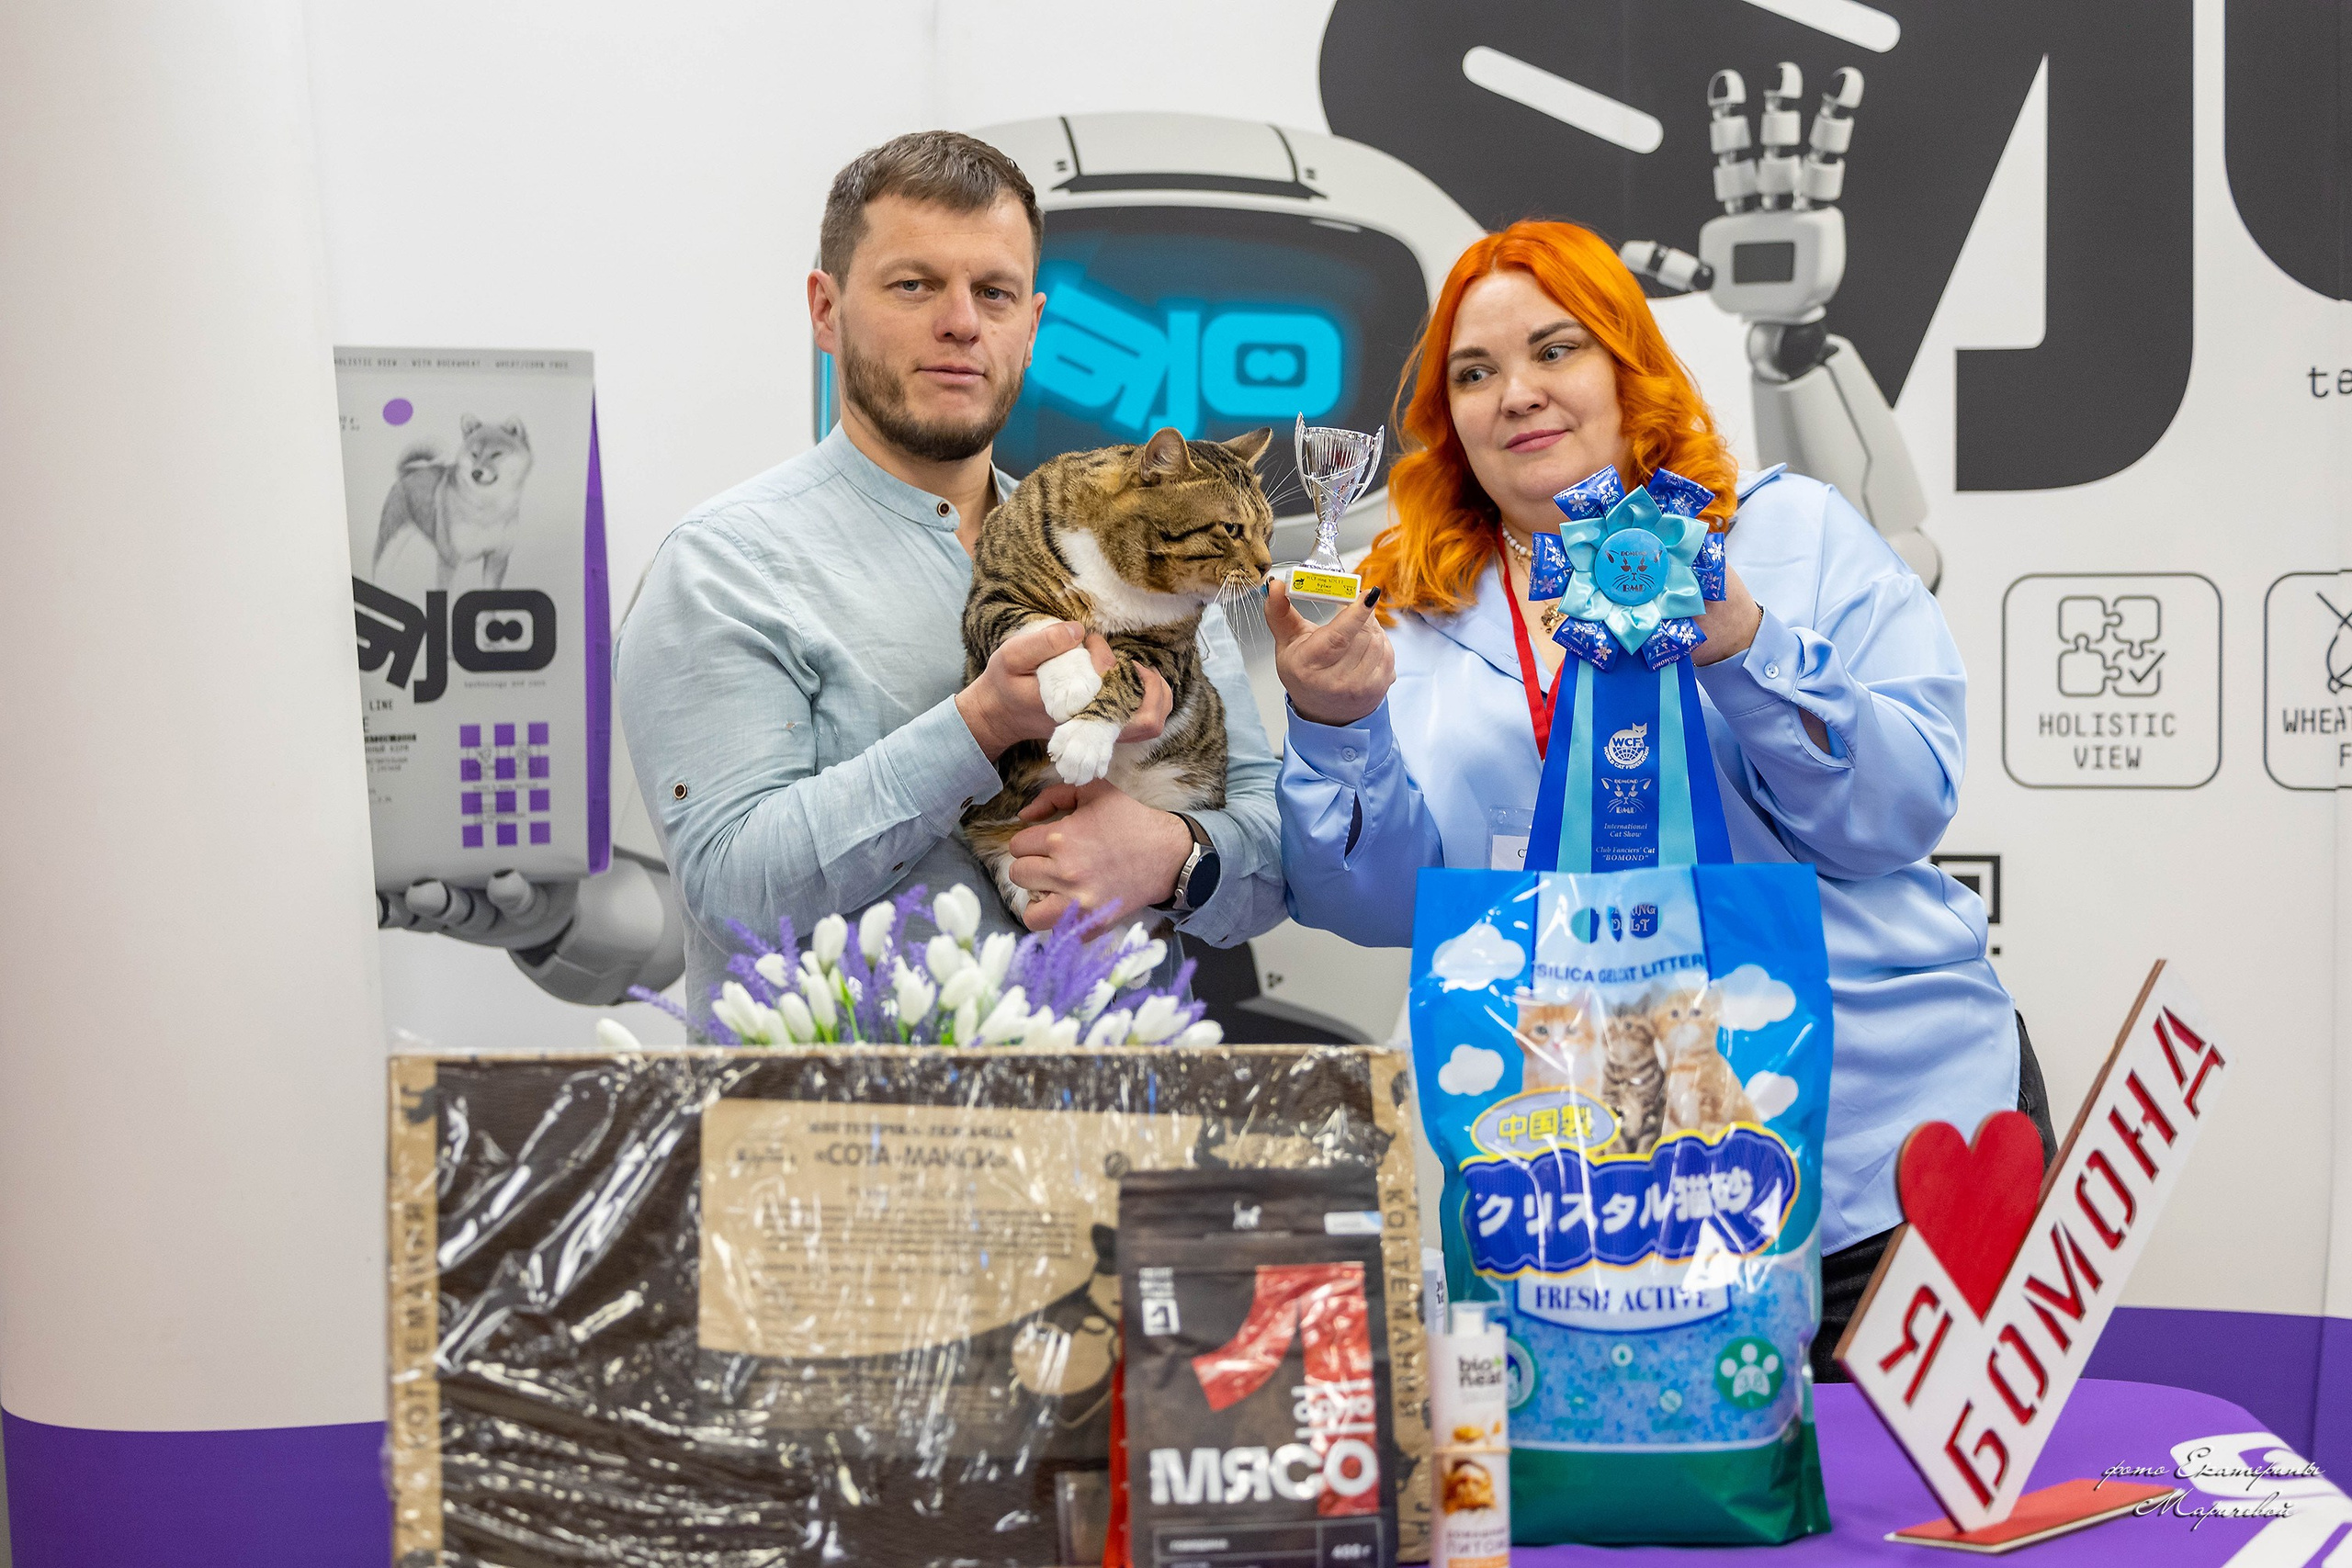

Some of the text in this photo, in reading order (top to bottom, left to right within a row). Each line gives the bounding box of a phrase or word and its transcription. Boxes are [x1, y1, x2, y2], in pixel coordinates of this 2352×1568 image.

[1623, 584, 1647, 592] BMD
[369, 698, 393, 712] LINE
[2038, 713, 2177, 738] HOLISTIC
[1612, 737, 1641, 747] WCF
[1603, 746, 1615, 765] WORLD
[1625, 745, 1650, 770] FEDERATION
[2074, 745, 2143, 770] VIEW
[1643, 846, 1656, 854] Cat
[1536, 963, 1594, 983] SILICA
[1641, 953, 1705, 978] LITTER
[1498, 1107, 1595, 1141] 中国製
[1476, 1166, 1756, 1238] クリスタル猫砂
[1943, 1005, 2226, 1508] БОМОНД
[1534, 1283, 1712, 1313] FRESH ACTIVE
[1878, 1283, 1953, 1407] Я
[1457, 1355, 1493, 1371] bio
[1149, 1438, 1379, 1506] МЯСО
